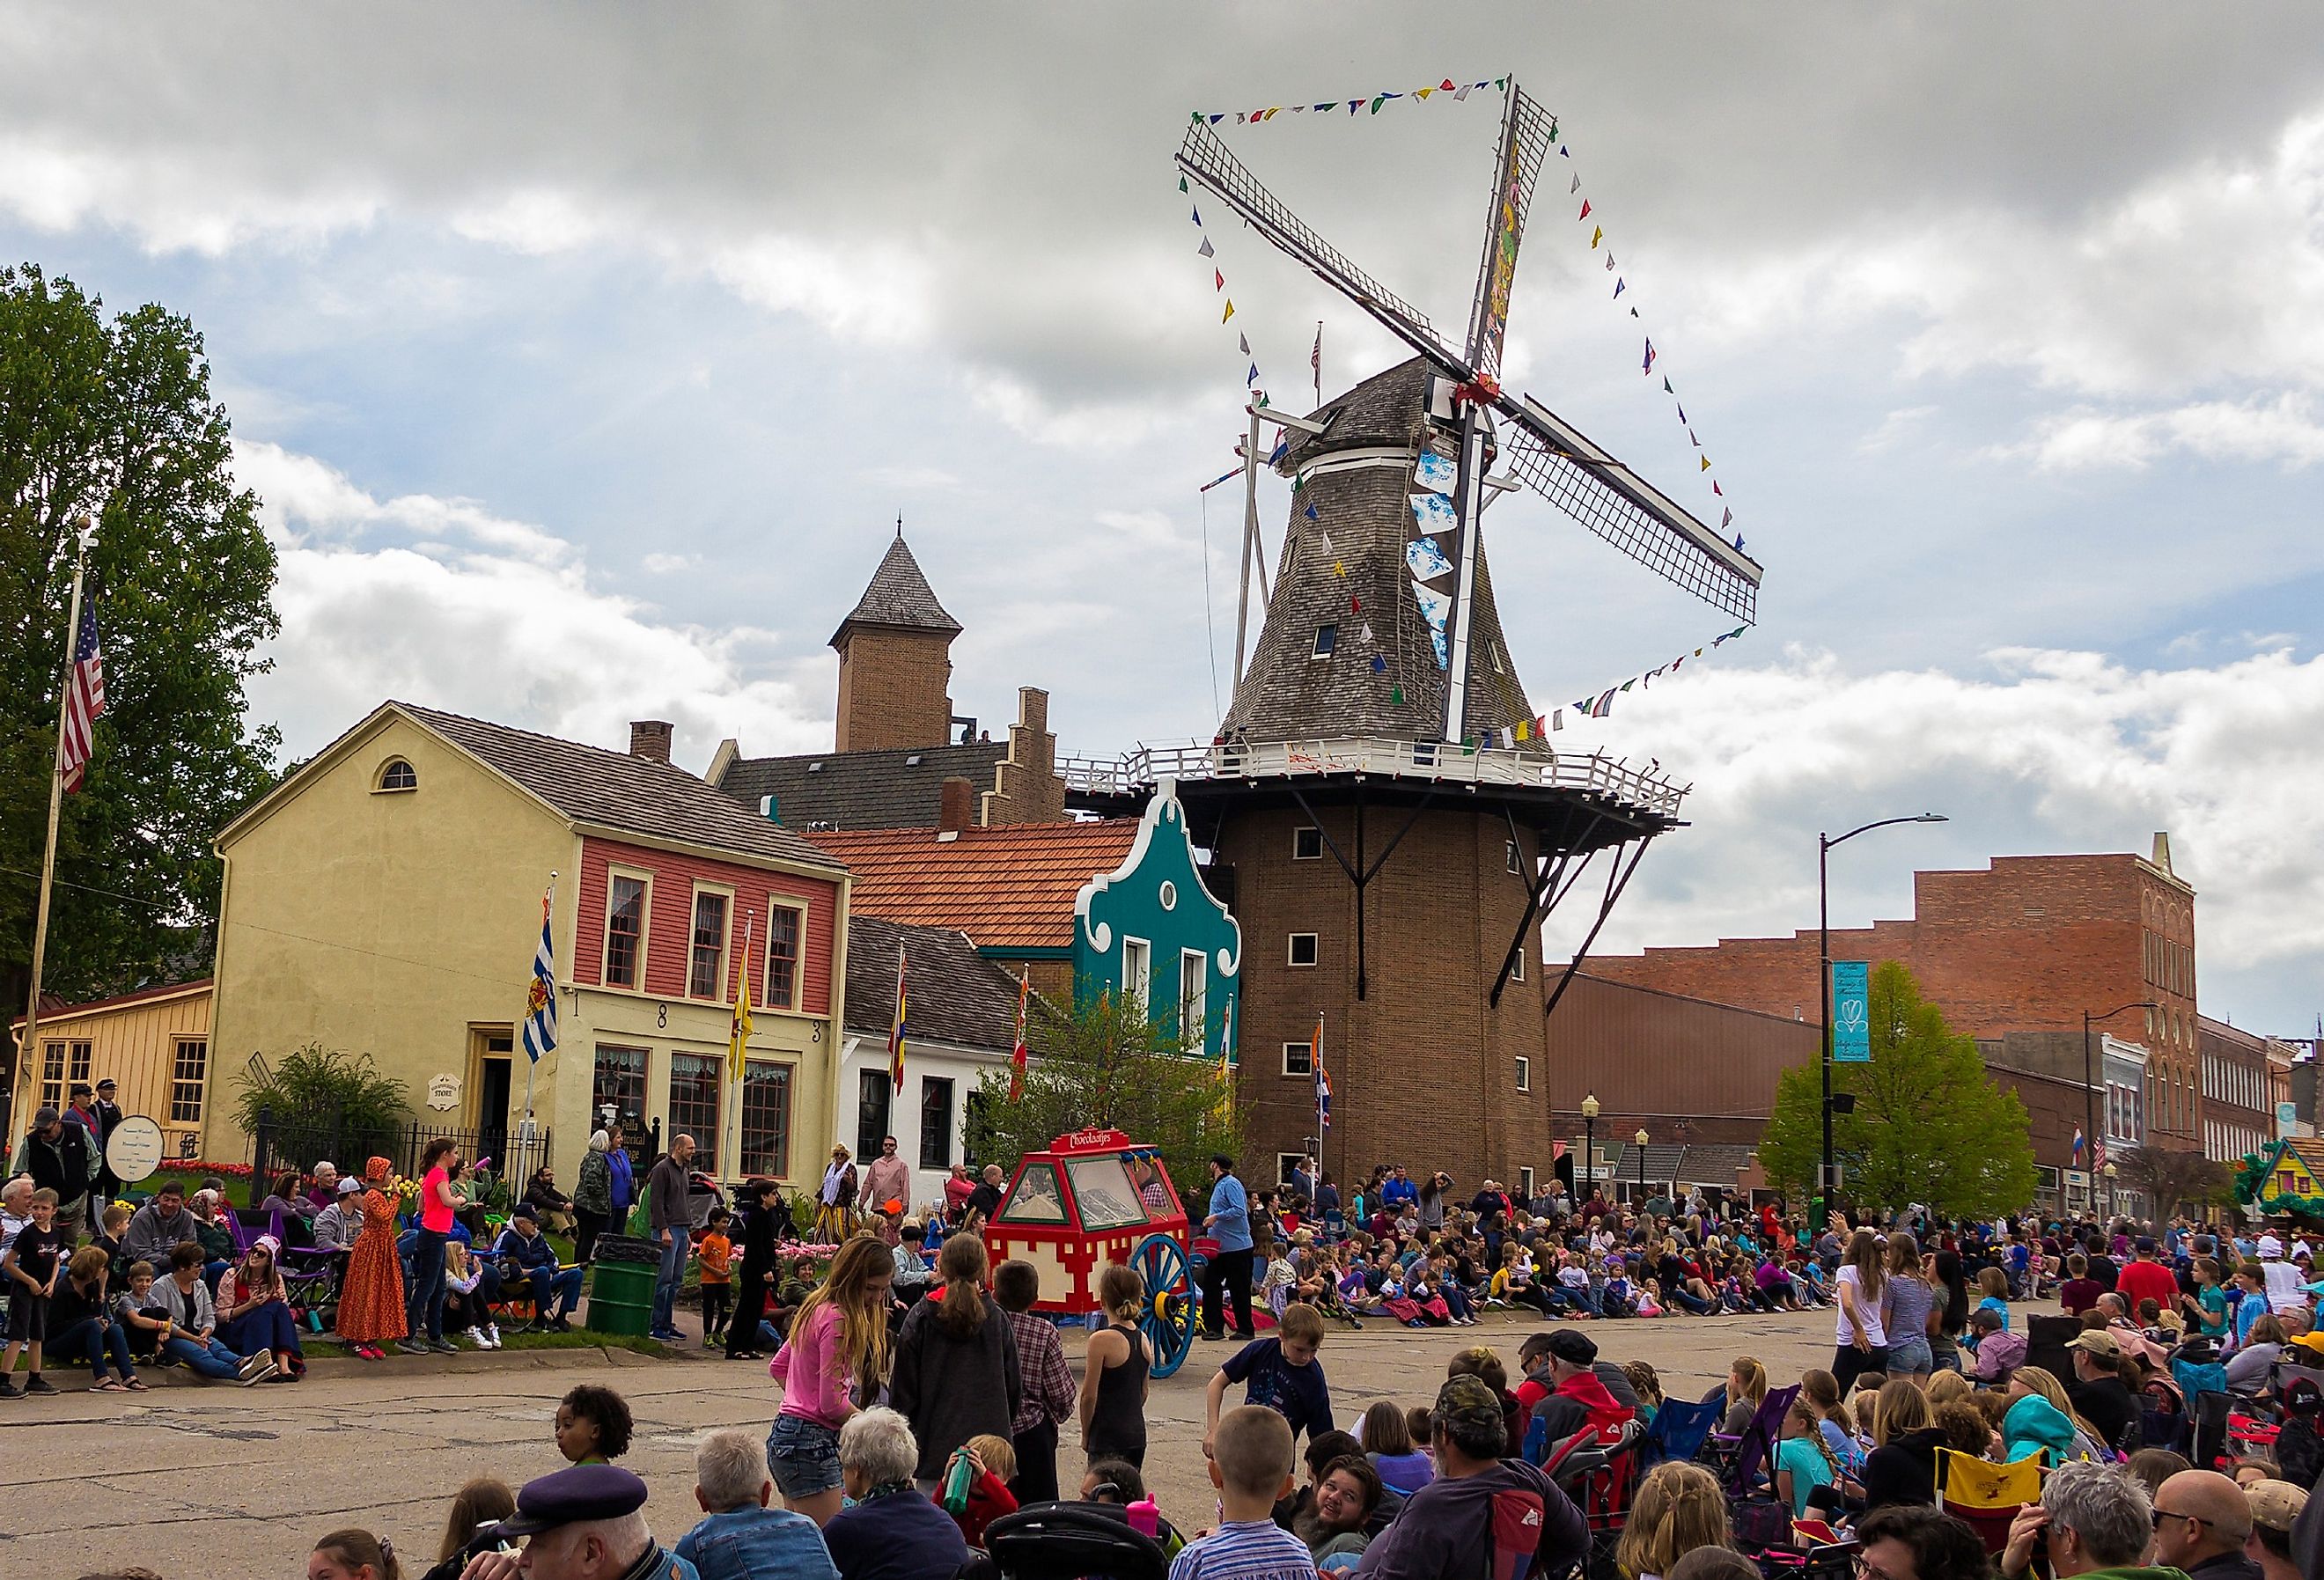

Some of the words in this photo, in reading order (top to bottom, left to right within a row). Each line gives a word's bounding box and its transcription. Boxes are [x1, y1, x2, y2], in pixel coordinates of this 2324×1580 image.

[657, 1003, 667, 1029] 8
[812, 1019, 821, 1043] 3
[621, 1118, 638, 1132] Pella
